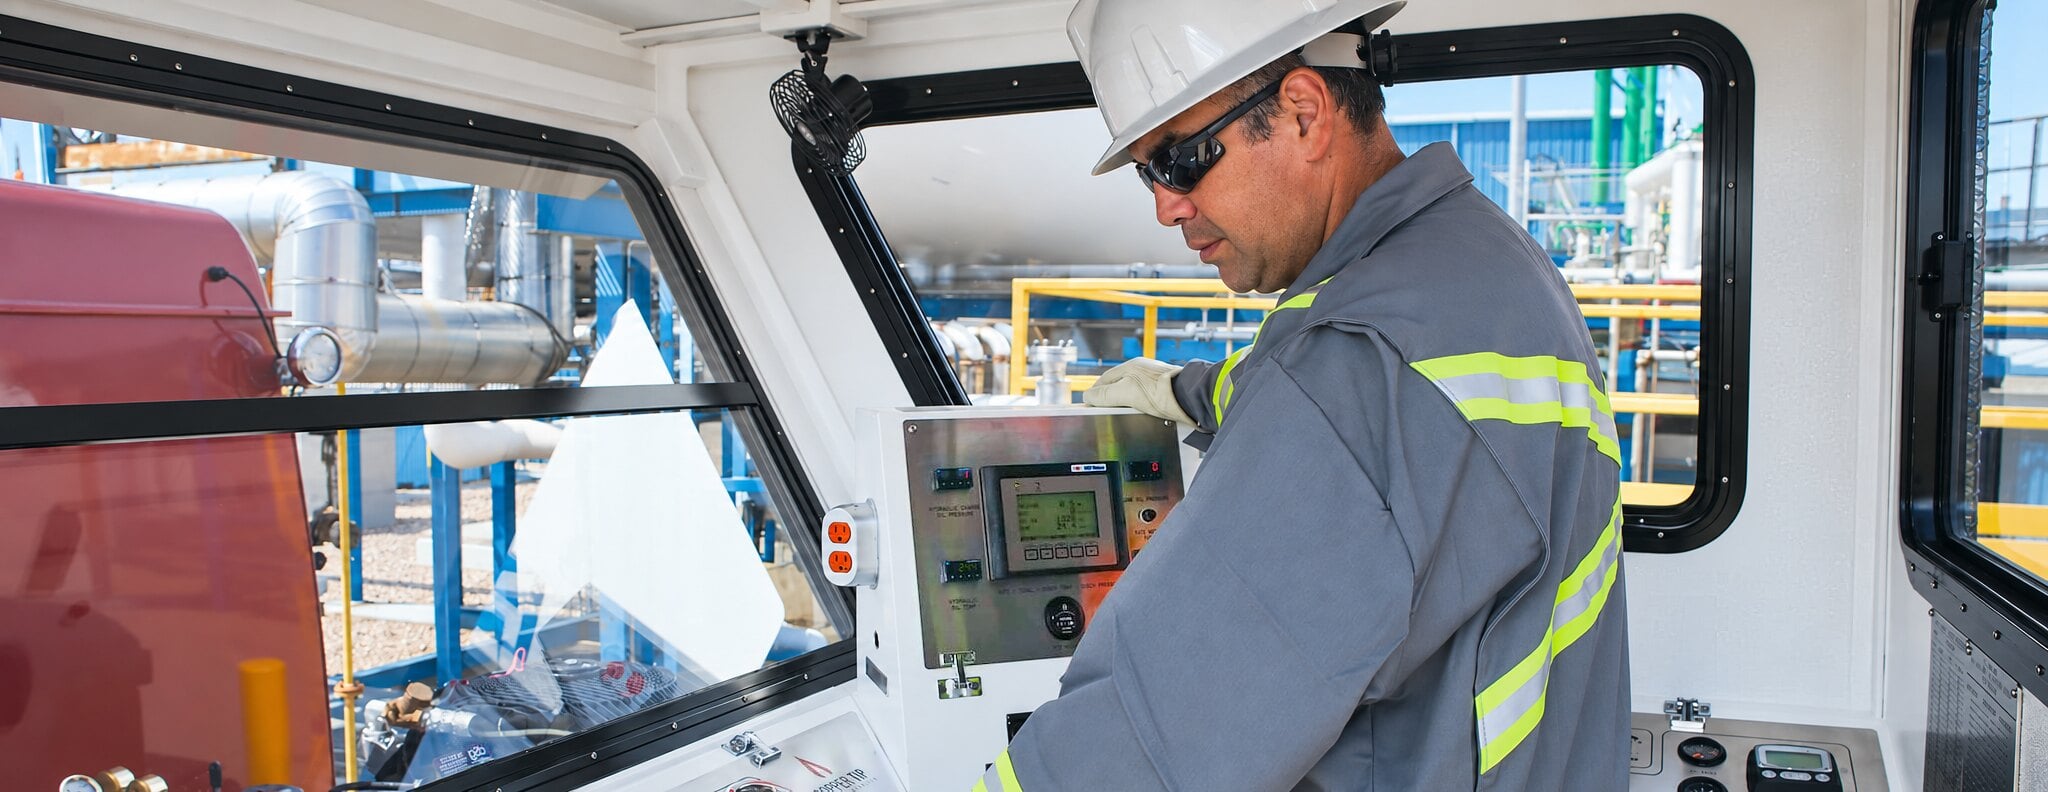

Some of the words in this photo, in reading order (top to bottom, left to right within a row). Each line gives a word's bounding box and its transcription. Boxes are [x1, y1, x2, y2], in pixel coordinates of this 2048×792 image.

[1151, 462, 1159, 472] 0
[813, 776, 856, 792] OPPER
[846, 768, 868, 782] TIP
